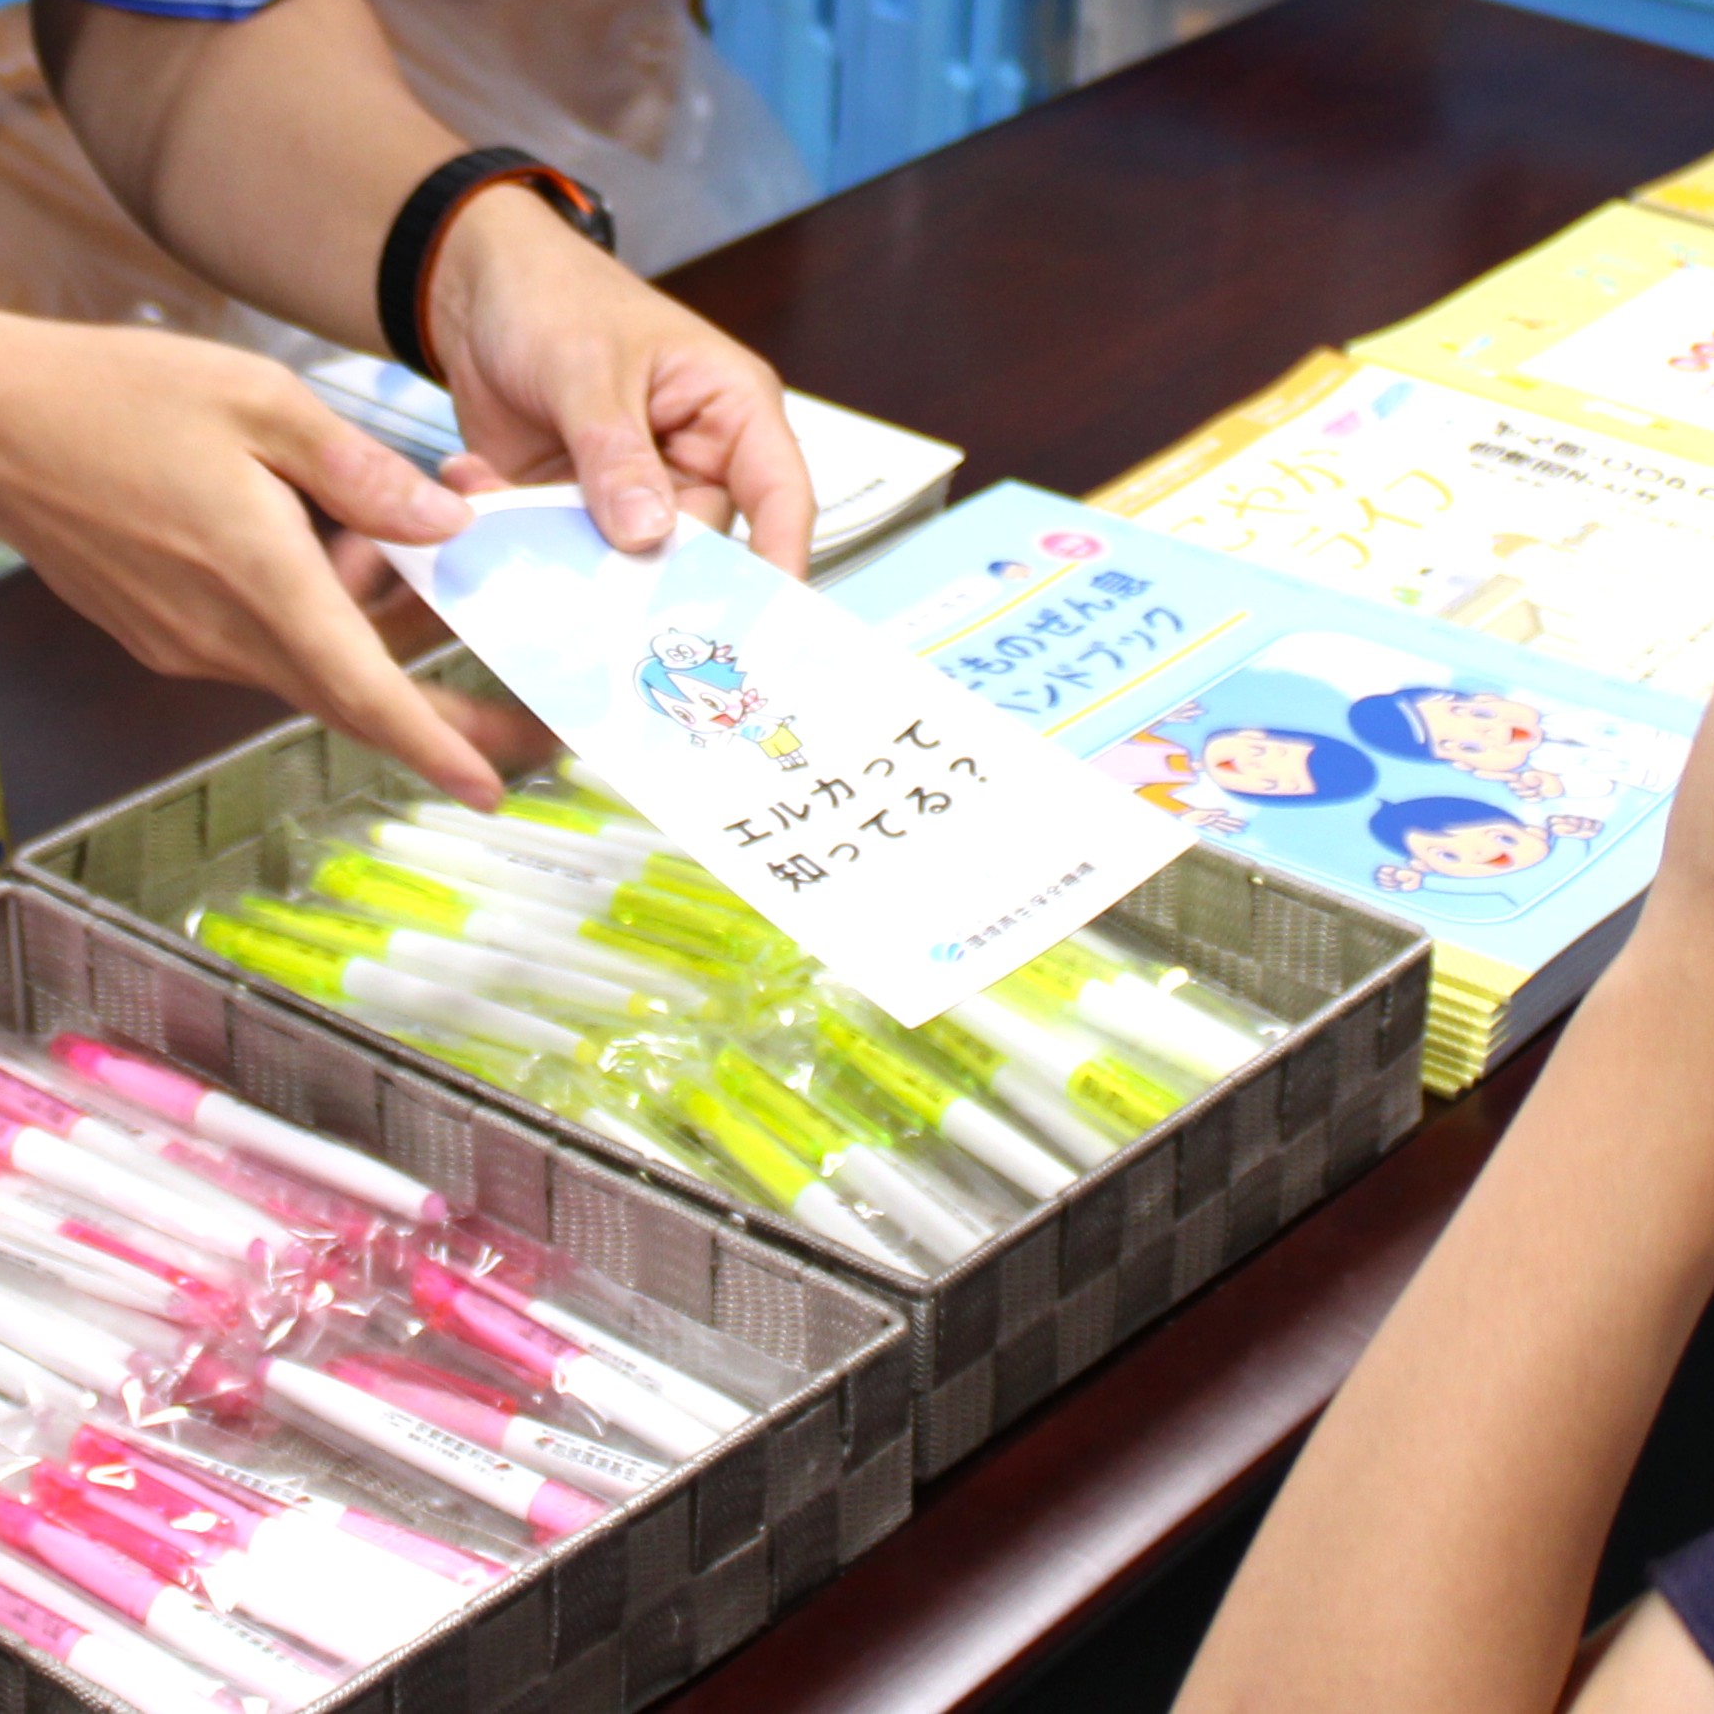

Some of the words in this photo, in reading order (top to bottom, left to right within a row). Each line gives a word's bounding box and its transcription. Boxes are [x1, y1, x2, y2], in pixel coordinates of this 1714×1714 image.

[723, 718, 941, 848] エルカって
[766, 757, 987, 893] 知ってる？
